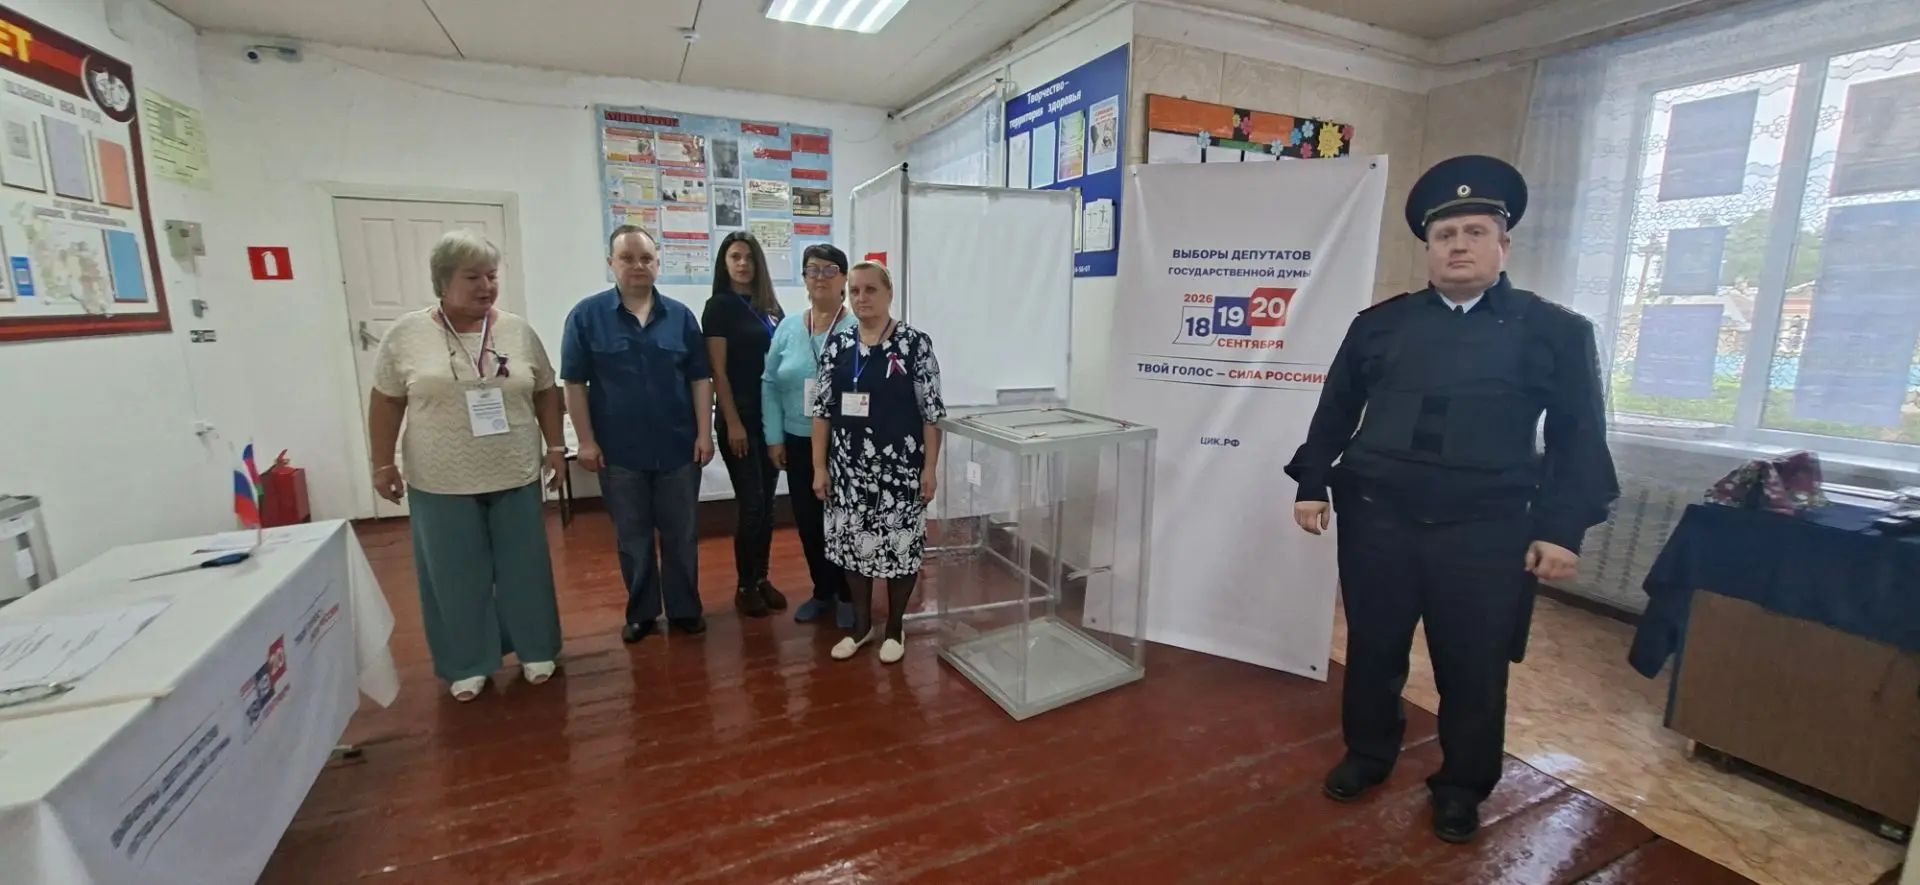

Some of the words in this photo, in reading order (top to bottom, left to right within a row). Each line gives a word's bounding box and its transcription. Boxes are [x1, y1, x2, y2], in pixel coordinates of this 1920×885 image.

[1009, 107, 1043, 129] территория
[1048, 89, 1081, 113] здоровья
[1172, 249, 1229, 260] ВЫБОРЫ
[1231, 249, 1311, 261] ДЕПУТАТОВ
[1168, 266, 1274, 278] ГОСУДАРСТВЕННОЙ
[1277, 267, 1312, 279] ДУМЫ
[1183, 293, 1213, 304] 2026
[1185, 317, 1211, 337] 18
[1217, 305, 1244, 328] 19
[1251, 296, 1286, 319] 20
[1217, 339, 1284, 350] СЕНТЯБРЯ
[1137, 362, 1169, 373] ТВОЙ
[1172, 366, 1213, 377] ГОЛОС
[1228, 369, 1262, 380] СИЛА
[1200, 436, 1240, 448] ЦИК.РФ
